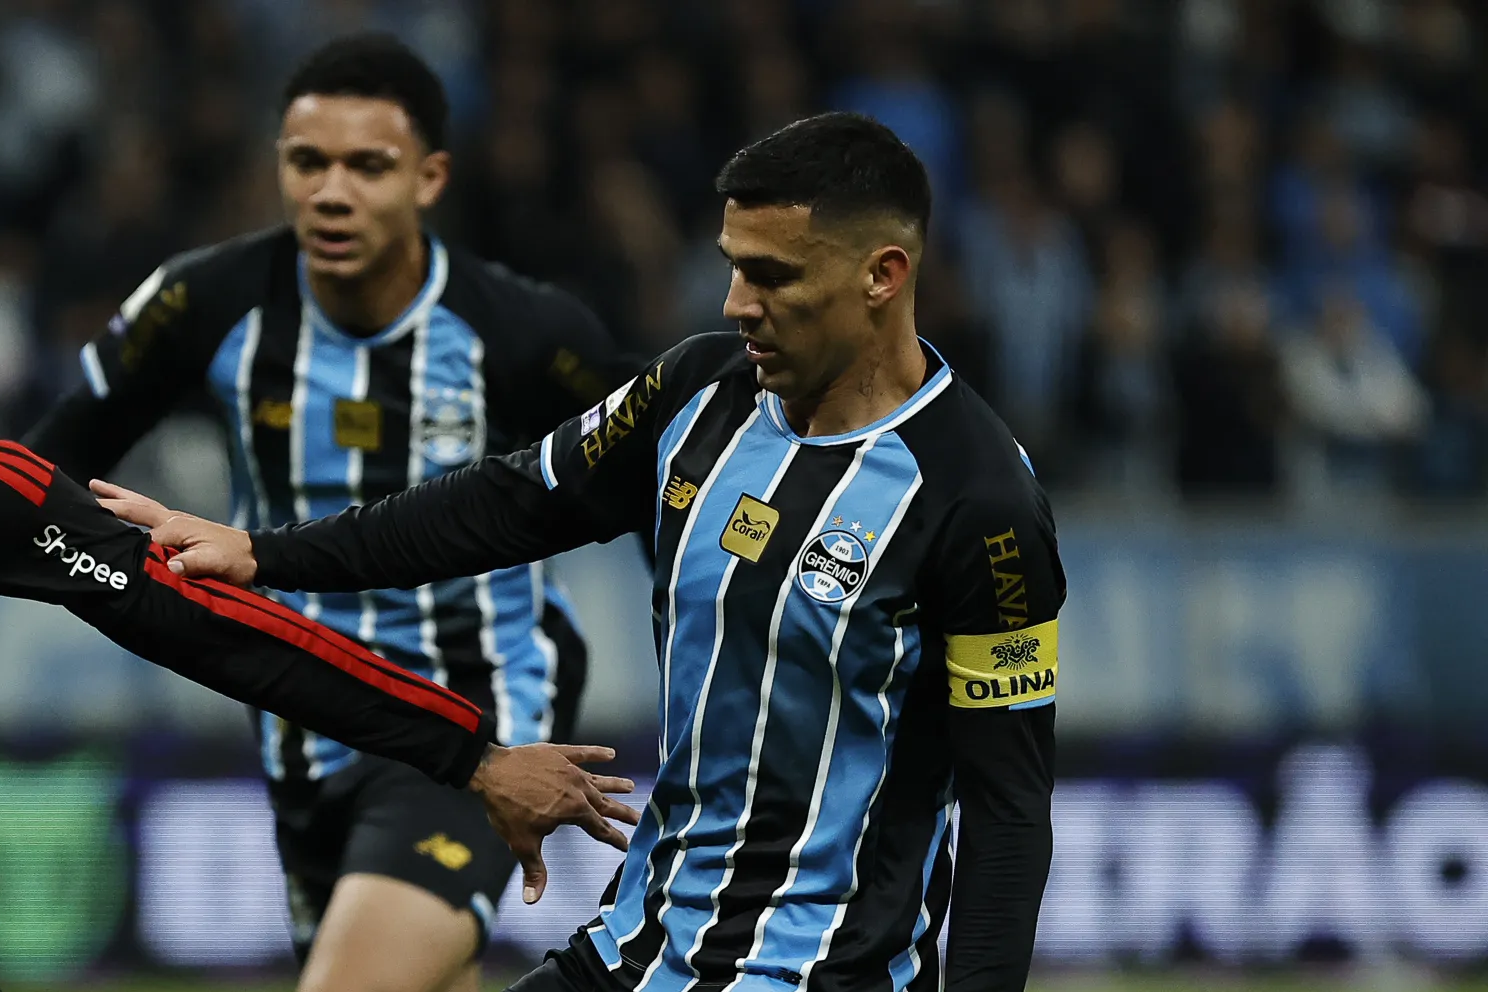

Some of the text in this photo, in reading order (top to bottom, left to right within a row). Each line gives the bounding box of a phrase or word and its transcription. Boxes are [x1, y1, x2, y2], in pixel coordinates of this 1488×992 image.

[580, 361, 664, 469] HAVAN
[731, 518, 766, 542] Coral
[33, 524, 129, 590] Shopee
[835, 545, 850, 556] 1903
[804, 551, 860, 586] GRÊMIO
